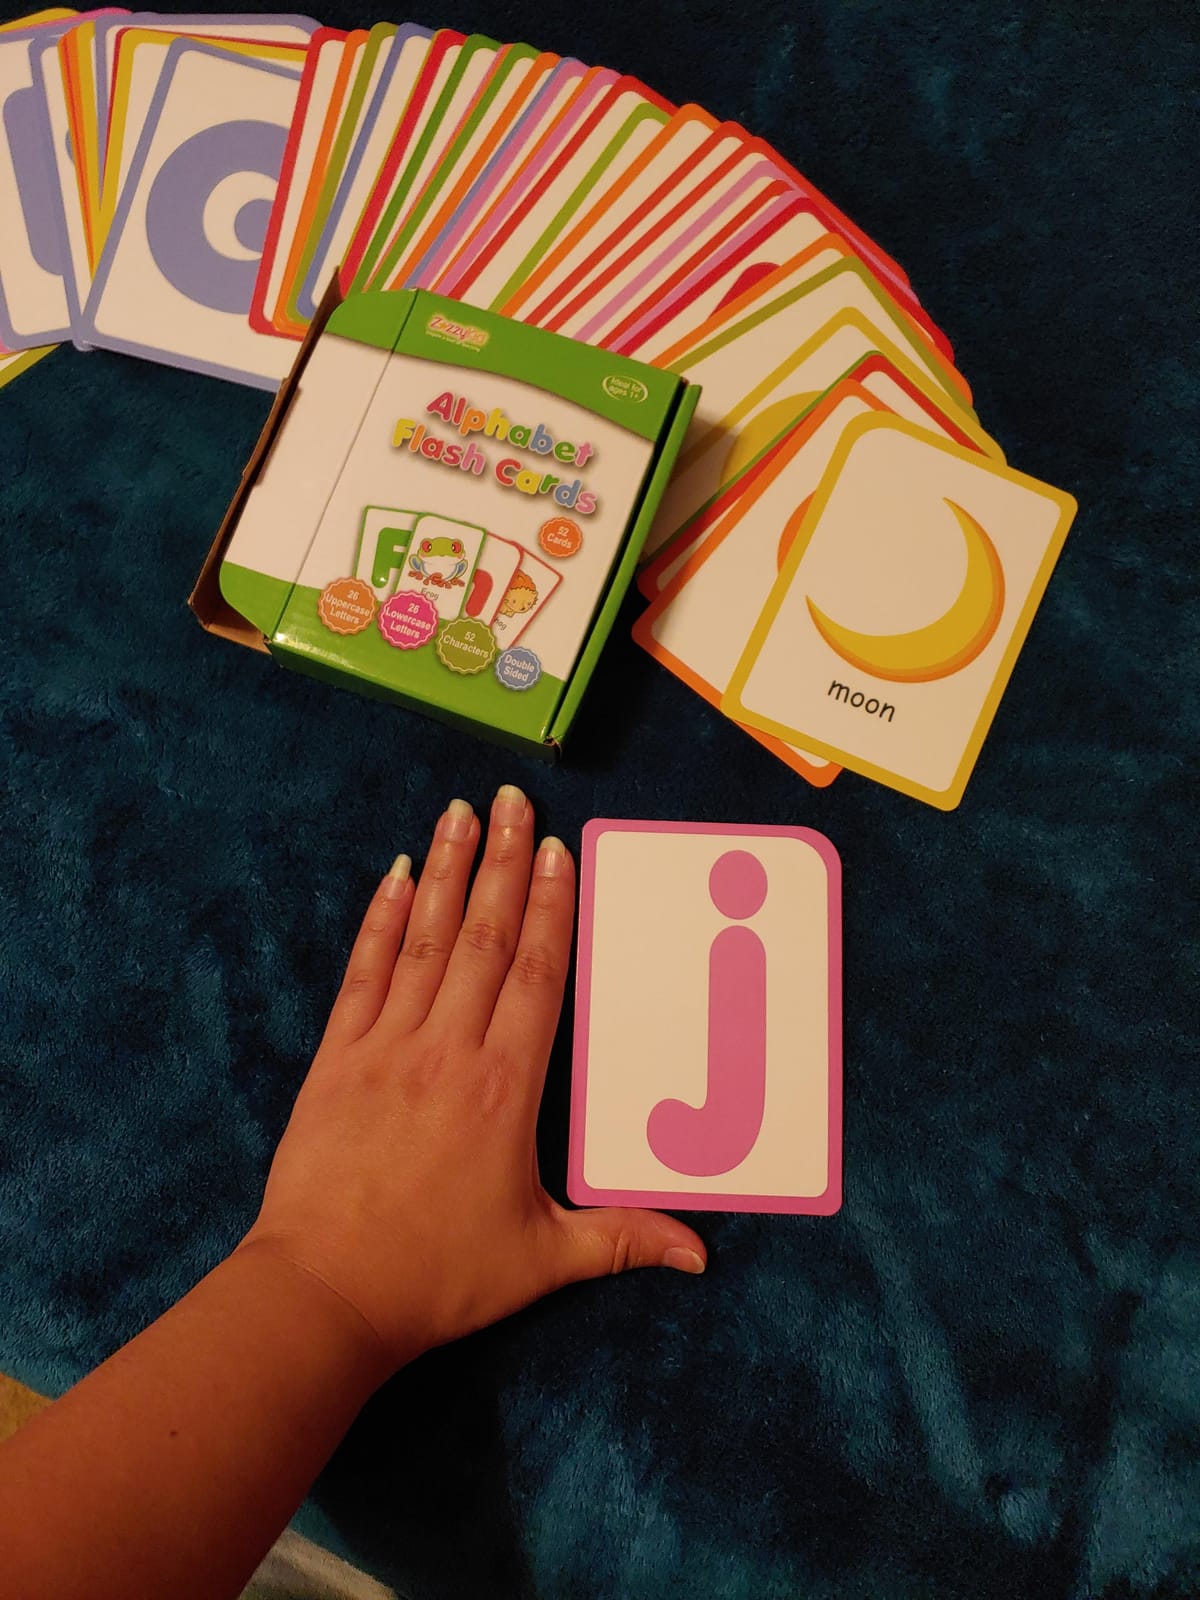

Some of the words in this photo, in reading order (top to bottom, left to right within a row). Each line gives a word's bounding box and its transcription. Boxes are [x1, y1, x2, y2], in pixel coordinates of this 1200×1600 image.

[426, 391, 594, 467] Alphabet
[392, 418, 486, 475] Flash
[495, 458, 597, 514] Cards
[547, 532, 572, 549] Cards
[558, 526, 570, 537] 52
[347, 590, 360, 601] 26
[325, 593, 370, 617] Uppercase
[407, 603, 420, 614] 26
[330, 607, 360, 625] Letters
[385, 607, 431, 630] Lowercase
[390, 620, 420, 639] Letters
[464, 631, 476, 642] 52
[443, 634, 489, 659] Characters
[504, 654, 535, 672] Double
[503, 666, 529, 681] Sided
[827, 680, 895, 722] moon
[646, 850, 768, 1177] j
